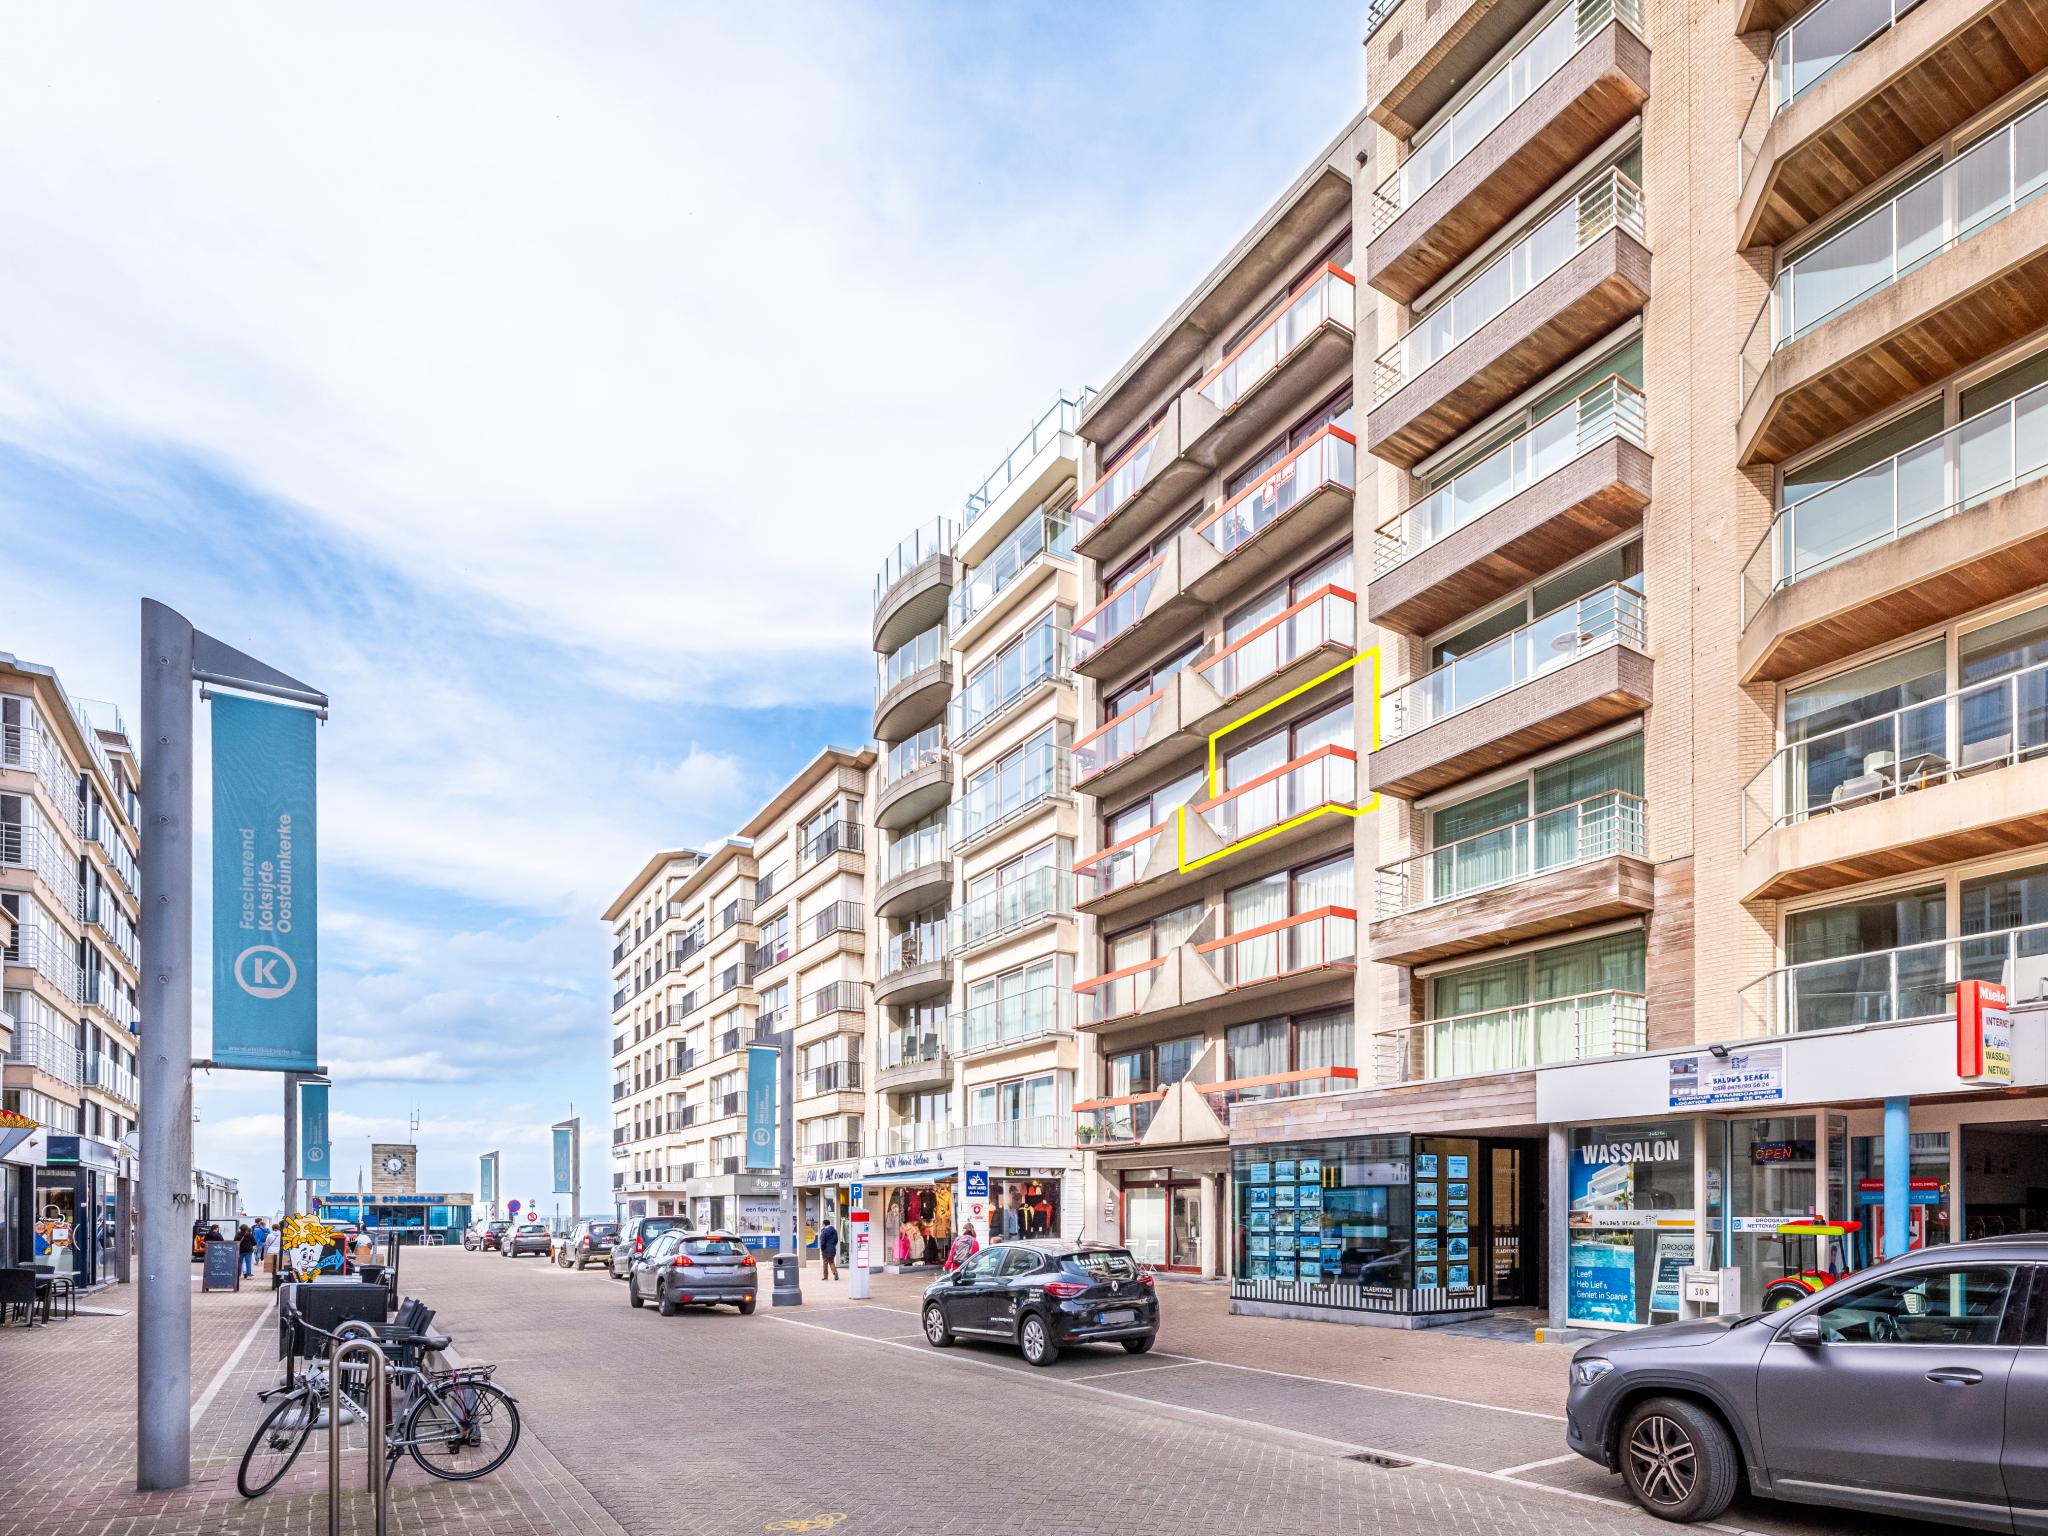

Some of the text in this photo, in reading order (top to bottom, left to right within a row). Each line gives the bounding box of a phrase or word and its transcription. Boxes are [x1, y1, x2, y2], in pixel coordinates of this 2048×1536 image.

[239, 828, 255, 930] Fascinerend
[276, 813, 292, 934] Oostduinkerke
[258, 860, 277, 931] Koksijde
[253, 957, 279, 985] K
[1979, 986, 2006, 1004] Miele
[1743, 1073, 1770, 1082] BEACH
[1677, 1089, 1777, 1102] VERHUUR STRANDCABINES
[1710, 1096, 1740, 1104] CABINES
[1581, 1140, 1680, 1165] WASSALON
[1755, 1146, 1792, 1161] OPEN
[756, 1178, 780, 1189] Pop-up
[853, 1186, 861, 1196] P
[757, 1206, 768, 1214] fijn
[1661, 1243, 1695, 1251] DROOGK
[320, 1256, 341, 1267] OPEN
[1576, 1280, 1590, 1288] Heb
[1590, 1280, 1603, 1289] Lief
[1576, 1290, 1628, 1302] Geniet in Spanje
